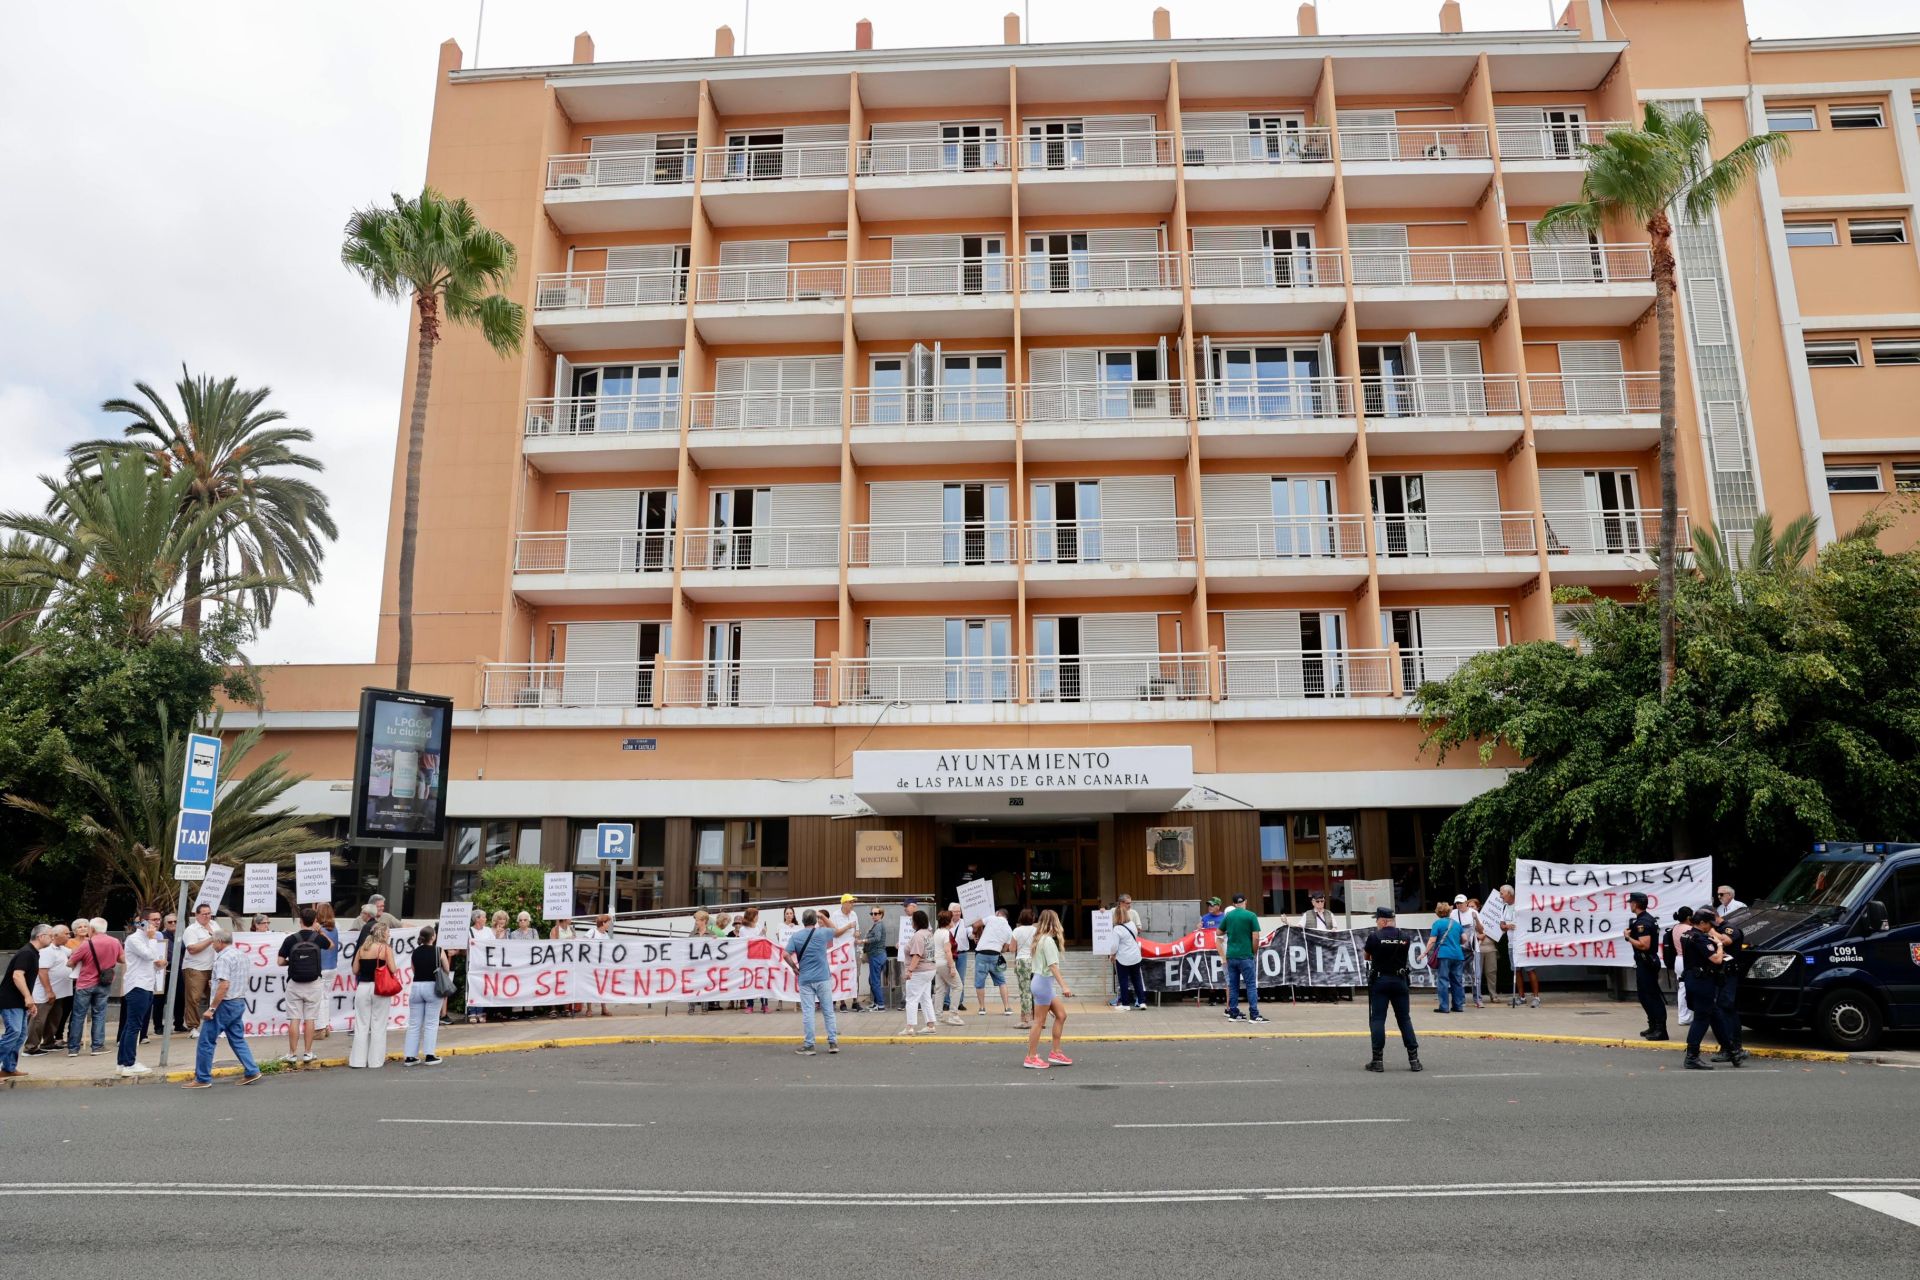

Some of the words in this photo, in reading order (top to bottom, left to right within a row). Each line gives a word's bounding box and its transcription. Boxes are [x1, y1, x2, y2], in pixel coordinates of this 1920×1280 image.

[386, 725, 397, 735] tu
[399, 727, 432, 738] ciudad
[936, 753, 1110, 771] AYUNTAMIENTO
[897, 777, 909, 788] de
[916, 777, 942, 788] LAS
[948, 776, 1004, 787] PALMAS
[1011, 776, 1028, 787] DE
[1035, 775, 1076, 786] GRAN
[1083, 773, 1149, 786] CANARIA
[181, 829, 209, 845] TAXI
[604, 829, 624, 854] P
[486, 946, 512, 968] EL
[642, 943, 672, 963] DE
[689, 941, 729, 961] LAS
[1526, 940, 1616, 959] NUESTRA
[1839, 946, 1857, 955] 091
[483, 972, 520, 997] NO
[535, 970, 568, 997] SE
